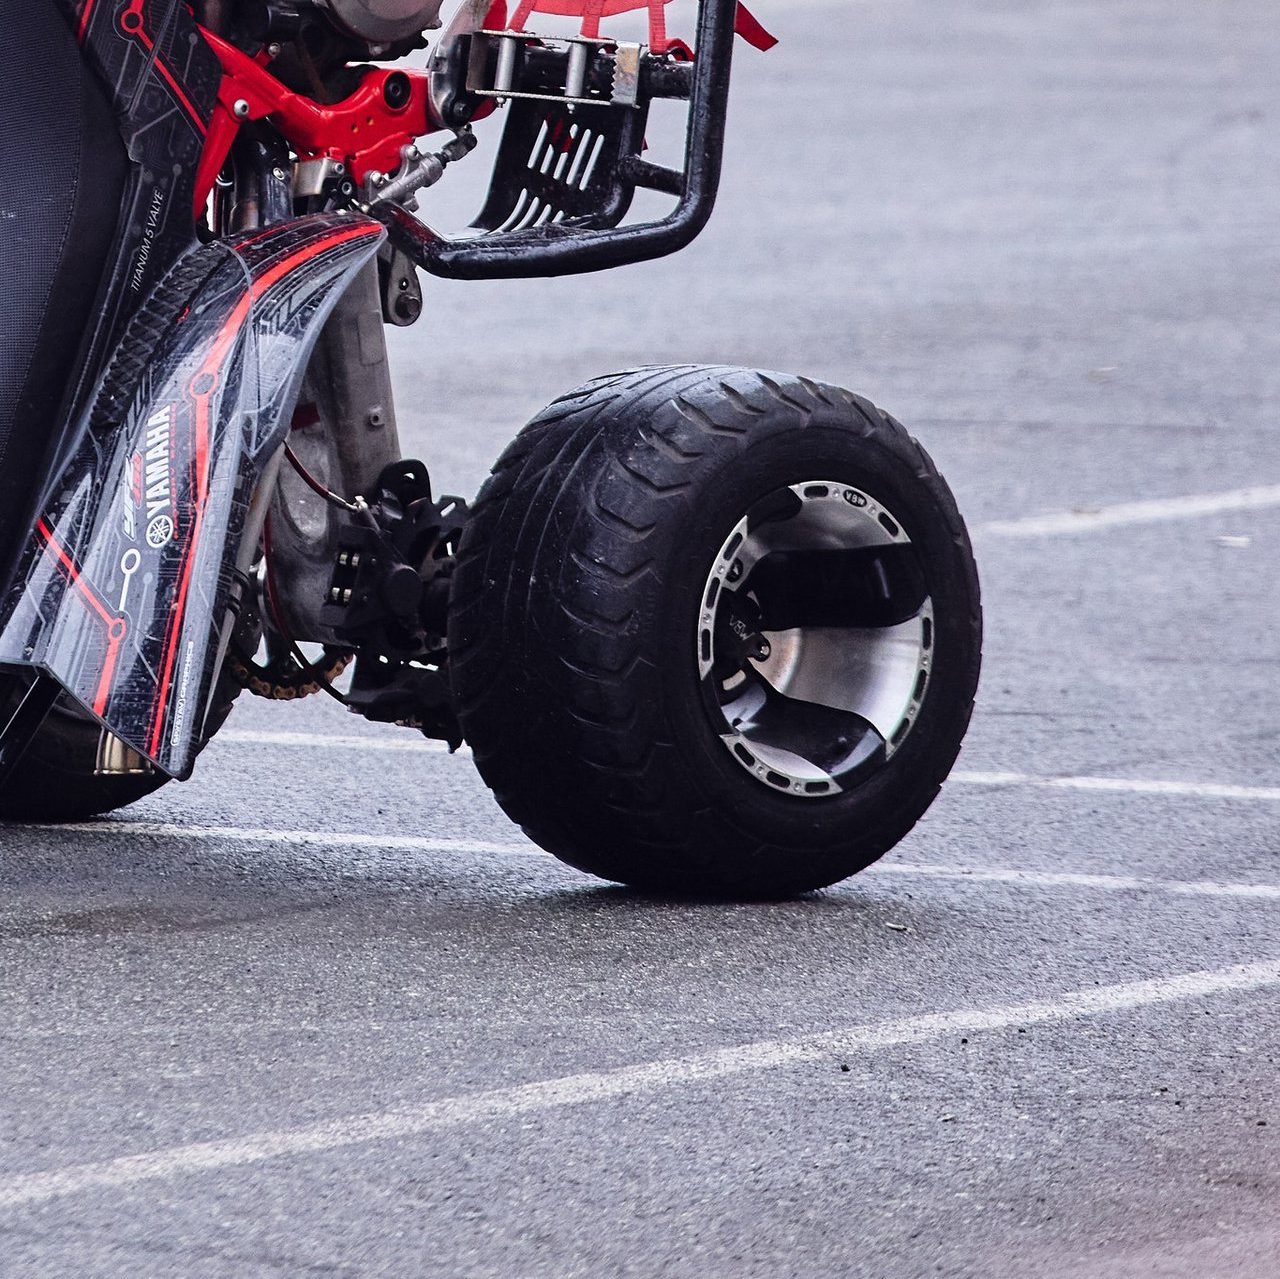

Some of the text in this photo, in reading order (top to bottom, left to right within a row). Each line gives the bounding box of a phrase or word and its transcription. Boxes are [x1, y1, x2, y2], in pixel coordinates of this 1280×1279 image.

[145, 228, 155, 239] 5
[145, 405, 171, 520] YAMAHA
[845, 491, 866, 506] VBW
